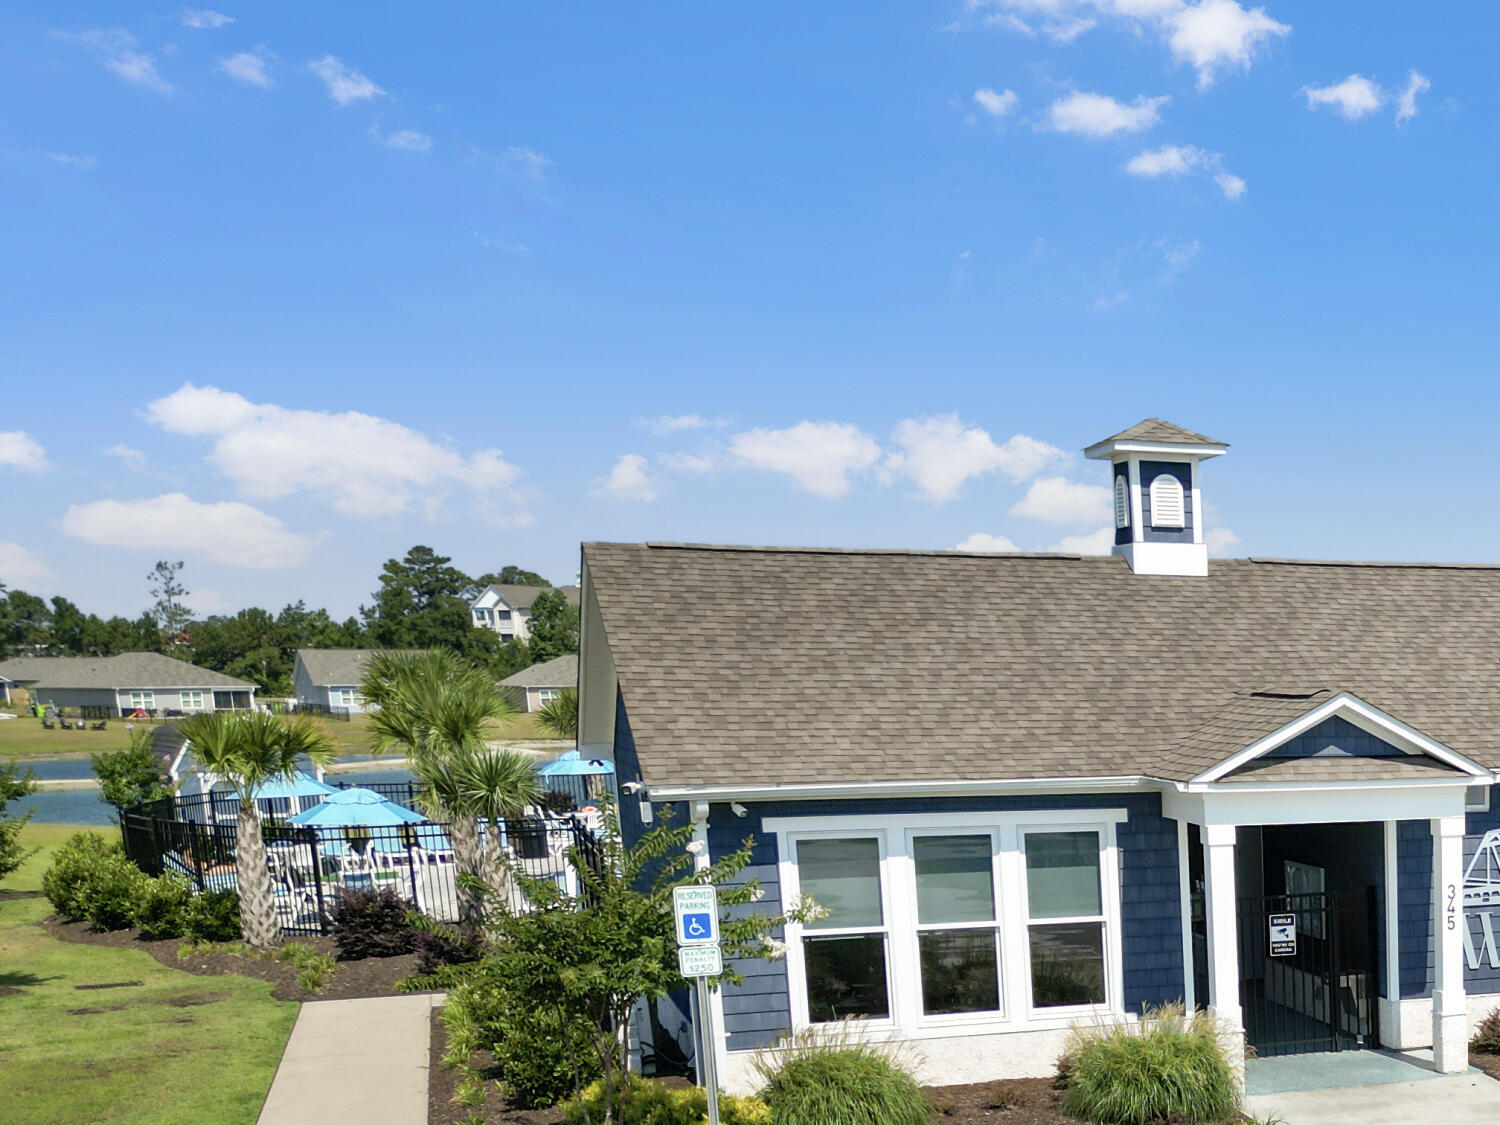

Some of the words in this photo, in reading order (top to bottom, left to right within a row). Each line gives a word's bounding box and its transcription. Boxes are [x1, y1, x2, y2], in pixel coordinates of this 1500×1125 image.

[677, 890, 713, 900] RESERVED
[679, 902, 711, 911] PARKING
[1447, 884, 1456, 931] 345
[689, 963, 714, 972] $250
